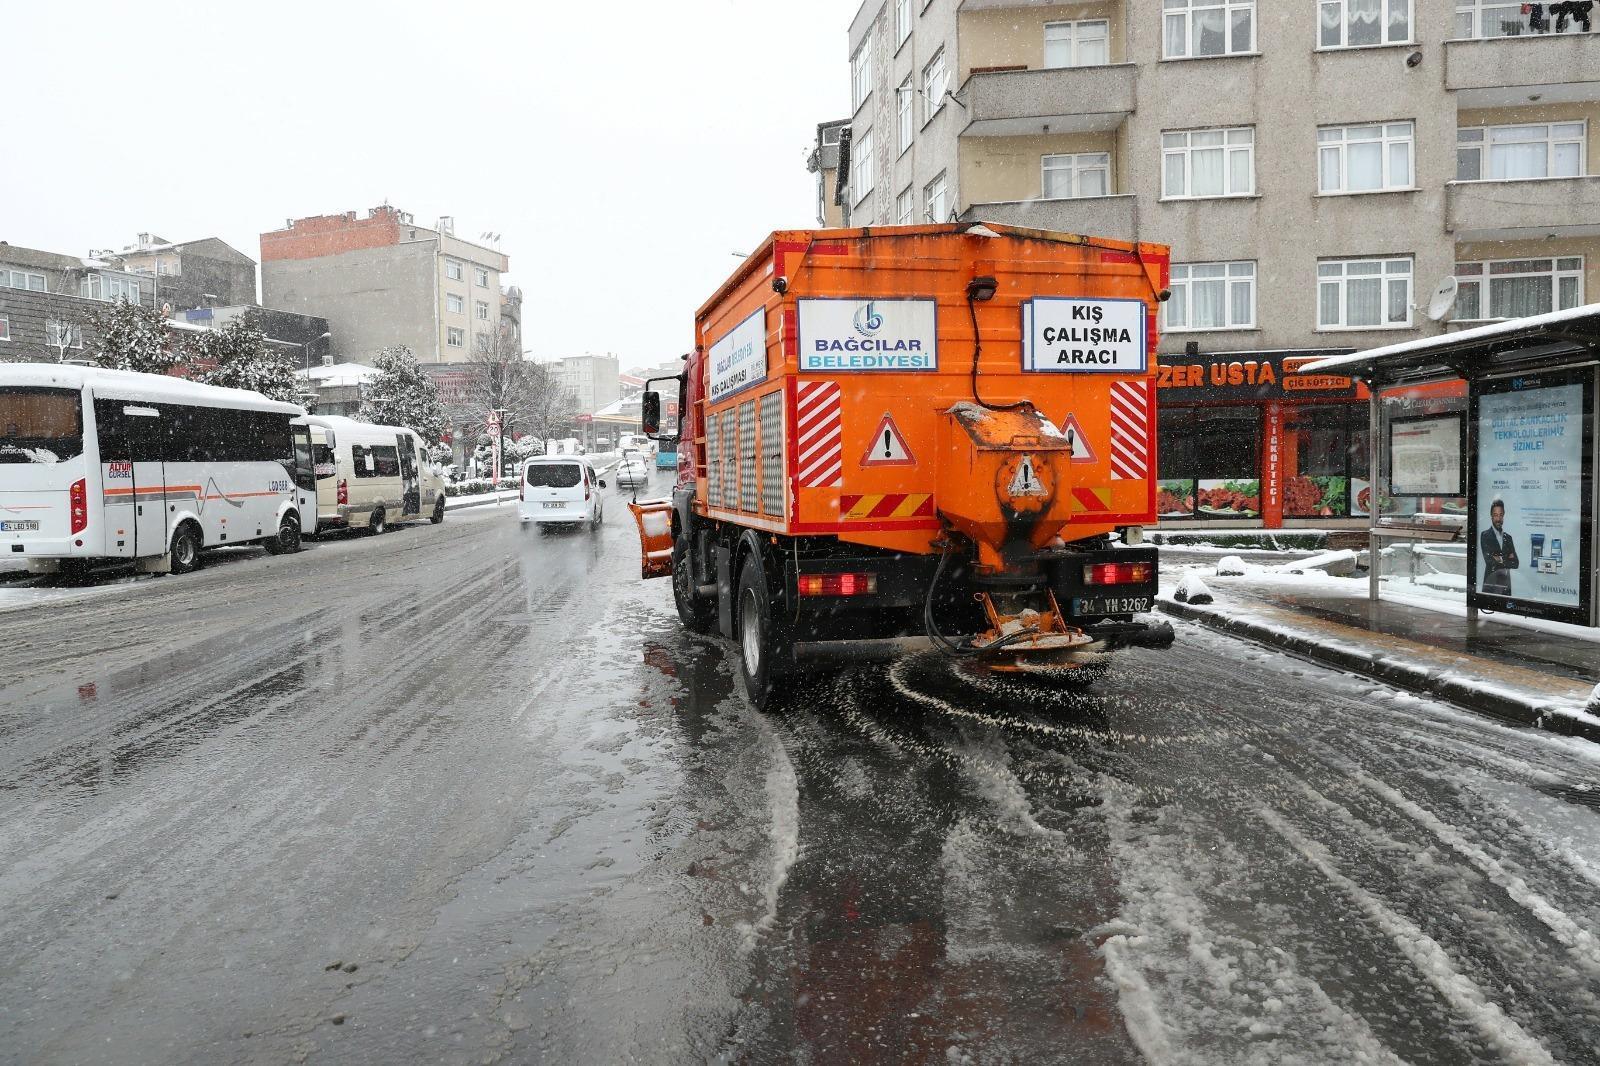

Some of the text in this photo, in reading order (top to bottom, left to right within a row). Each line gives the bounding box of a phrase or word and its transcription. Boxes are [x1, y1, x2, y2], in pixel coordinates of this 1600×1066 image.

[1072, 306, 1103, 324] KIŞ
[815, 337, 921, 351] BAĞCILAR
[1043, 327, 1131, 346] ÇALIŞMA
[808, 353, 929, 367] BELEDİYESİ
[1057, 350, 1117, 364] ARACI
[1211, 361, 1276, 386] USTA
[1081, 599, 1095, 613] 34
[1121, 597, 1148, 612] 3262
